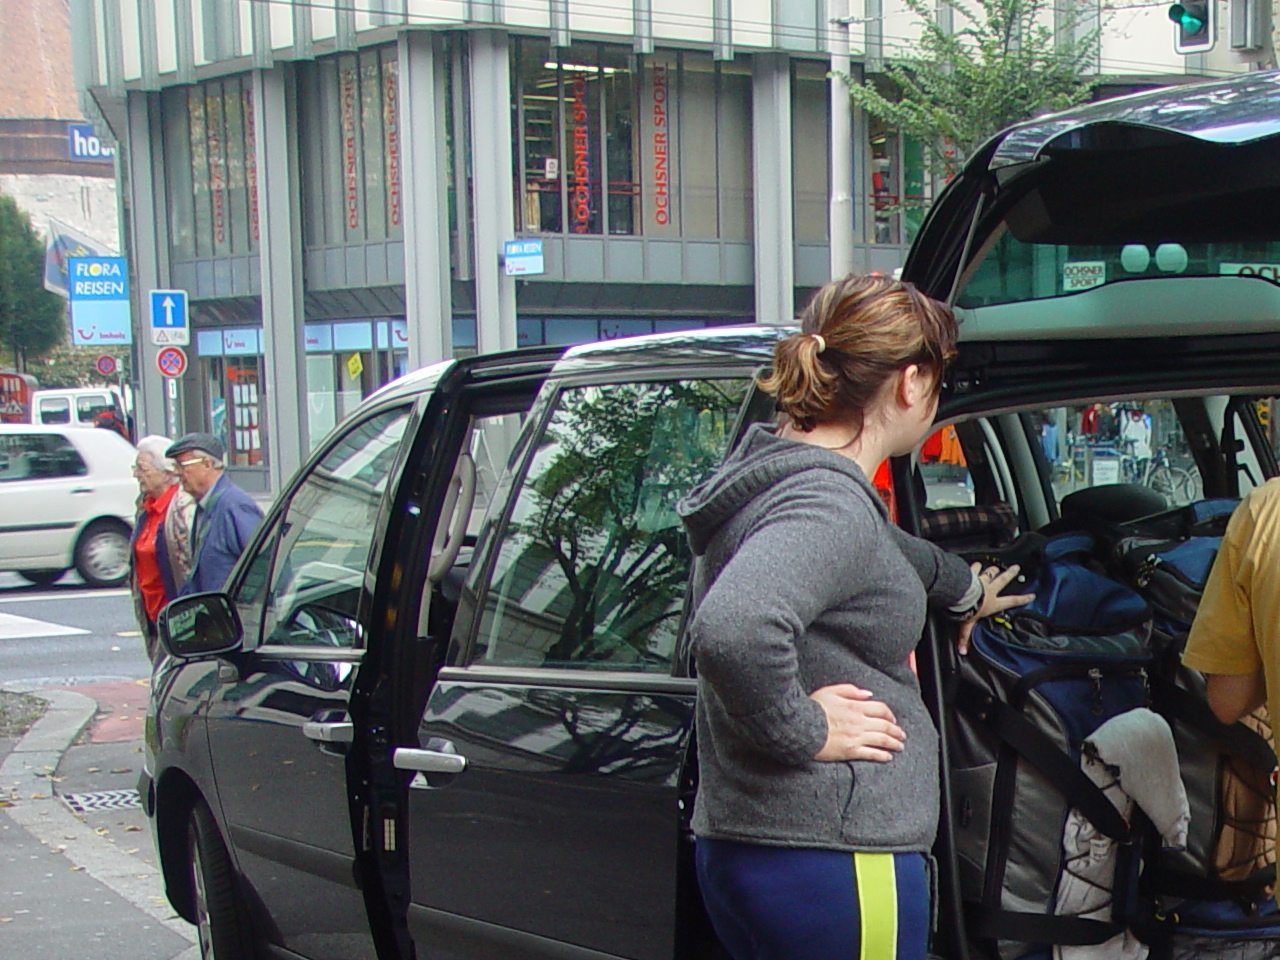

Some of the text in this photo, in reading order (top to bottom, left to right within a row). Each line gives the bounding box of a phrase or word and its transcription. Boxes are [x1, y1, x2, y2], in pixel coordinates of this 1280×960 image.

[572, 61, 587, 122] SPOR
[73, 129, 116, 157] ho
[652, 62, 668, 225] OCHSNER SPORT
[347, 137, 358, 229] OCHSNER
[388, 131, 399, 226] OCHSNER
[573, 126, 589, 222] OCHSNER
[75, 281, 124, 295] REISEN
[76, 263, 121, 276] FLORA
[1064, 265, 1103, 276] OCHSNER
[1070, 277, 1098, 288] SPORT
